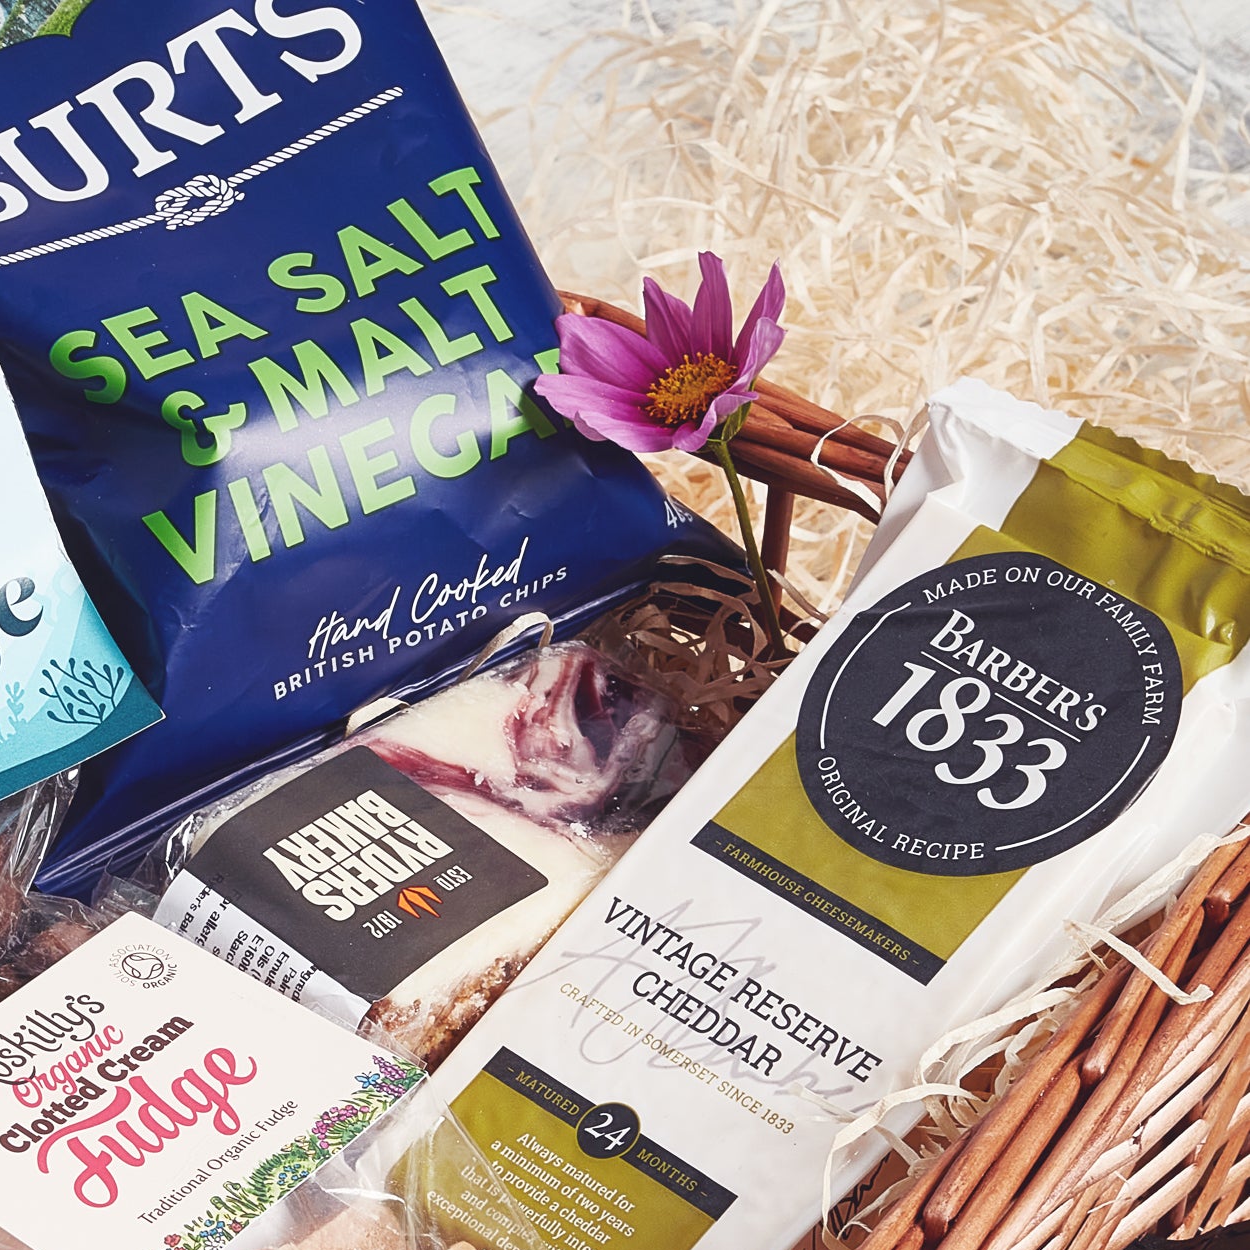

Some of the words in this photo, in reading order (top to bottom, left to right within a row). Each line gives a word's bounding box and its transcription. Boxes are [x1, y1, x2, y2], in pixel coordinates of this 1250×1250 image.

[48, 290, 267, 405] SEA
[267, 165, 502, 315] SALT
[160, 390, 246, 467] &
[247, 263, 515, 438] MALT
[273, 645, 375, 701] BRITISH
[389, 605, 487, 654] POTATO
[500, 566, 568, 608] CHIPS
[308, 586, 400, 658] Hand
[411, 537, 529, 625] Cooked
[922, 567, 998, 604] MADE
[1005, 566, 1042, 585] ON
[1047, 571, 1096, 600] OUR
[1096, 593, 1158, 657] FAMILY
[1141, 662, 1165, 725] FARM
[930, 609, 1107, 733] BARBER'S
[872, 661, 1067, 810] 1833
[262, 789, 412, 891] BAKERY
[817, 756, 885, 843] ORIGINAL
[893, 834, 985, 861] RECIPE
[302, 819, 454, 921] RYDERS
[721, 842, 805, 896] FARMHOUSE
[802, 891, 911, 962] CHEESEMAKERS
[109, 944, 172, 967] ASSOCIATION
[143, 964, 177, 989] ORGANIC
[362, 909, 402, 939] 1972
[603, 897, 738, 993] VINTAGE
[731, 977, 883, 1083] RESERVE
[632, 970, 783, 1077] CHEDDAR
[11, 1025, 124, 1108] Organic
[97, 1016, 195, 1081] Cream
[559, 982, 625, 1027] CRAFTED
[623, 1019, 644, 1037] IN
[641, 1032, 719, 1085] SOMERSET
[717, 1079, 764, 1116] SINCE
[761, 1107, 796, 1135] 1833
[36, 1047, 257, 1209] Fudge
[137, 1167, 211, 1227] Traditional
[207, 1130, 261, 1172] Organic
[256, 1098, 298, 1136] Fudge
[515, 1071, 581, 1117] MATURED
[584, 1113, 632, 1150] 24
[636, 1148, 699, 1192] MONTHS
[517, 1132, 565, 1173] Always
[565, 1161, 617, 1203] matured
[617, 1194, 636, 1214] for
[427, 1189, 499, 1242] exceptional
[460, 1165, 487, 1190] that
[486, 1180, 500, 1197] is
[500, 1192, 567, 1241] pwerfully
[461, 1189, 486, 1211] and
[491, 1141, 500, 1150] a
[500, 1146, 562, 1190] minimum
[561, 1184, 579, 1203] of
[579, 1191, 601, 1214] two
[599, 1209, 635, 1237] years
[501, 1172, 550, 1209] provide
[550, 1201, 559, 1211] a
[558, 1201, 612, 1245] cheddar
